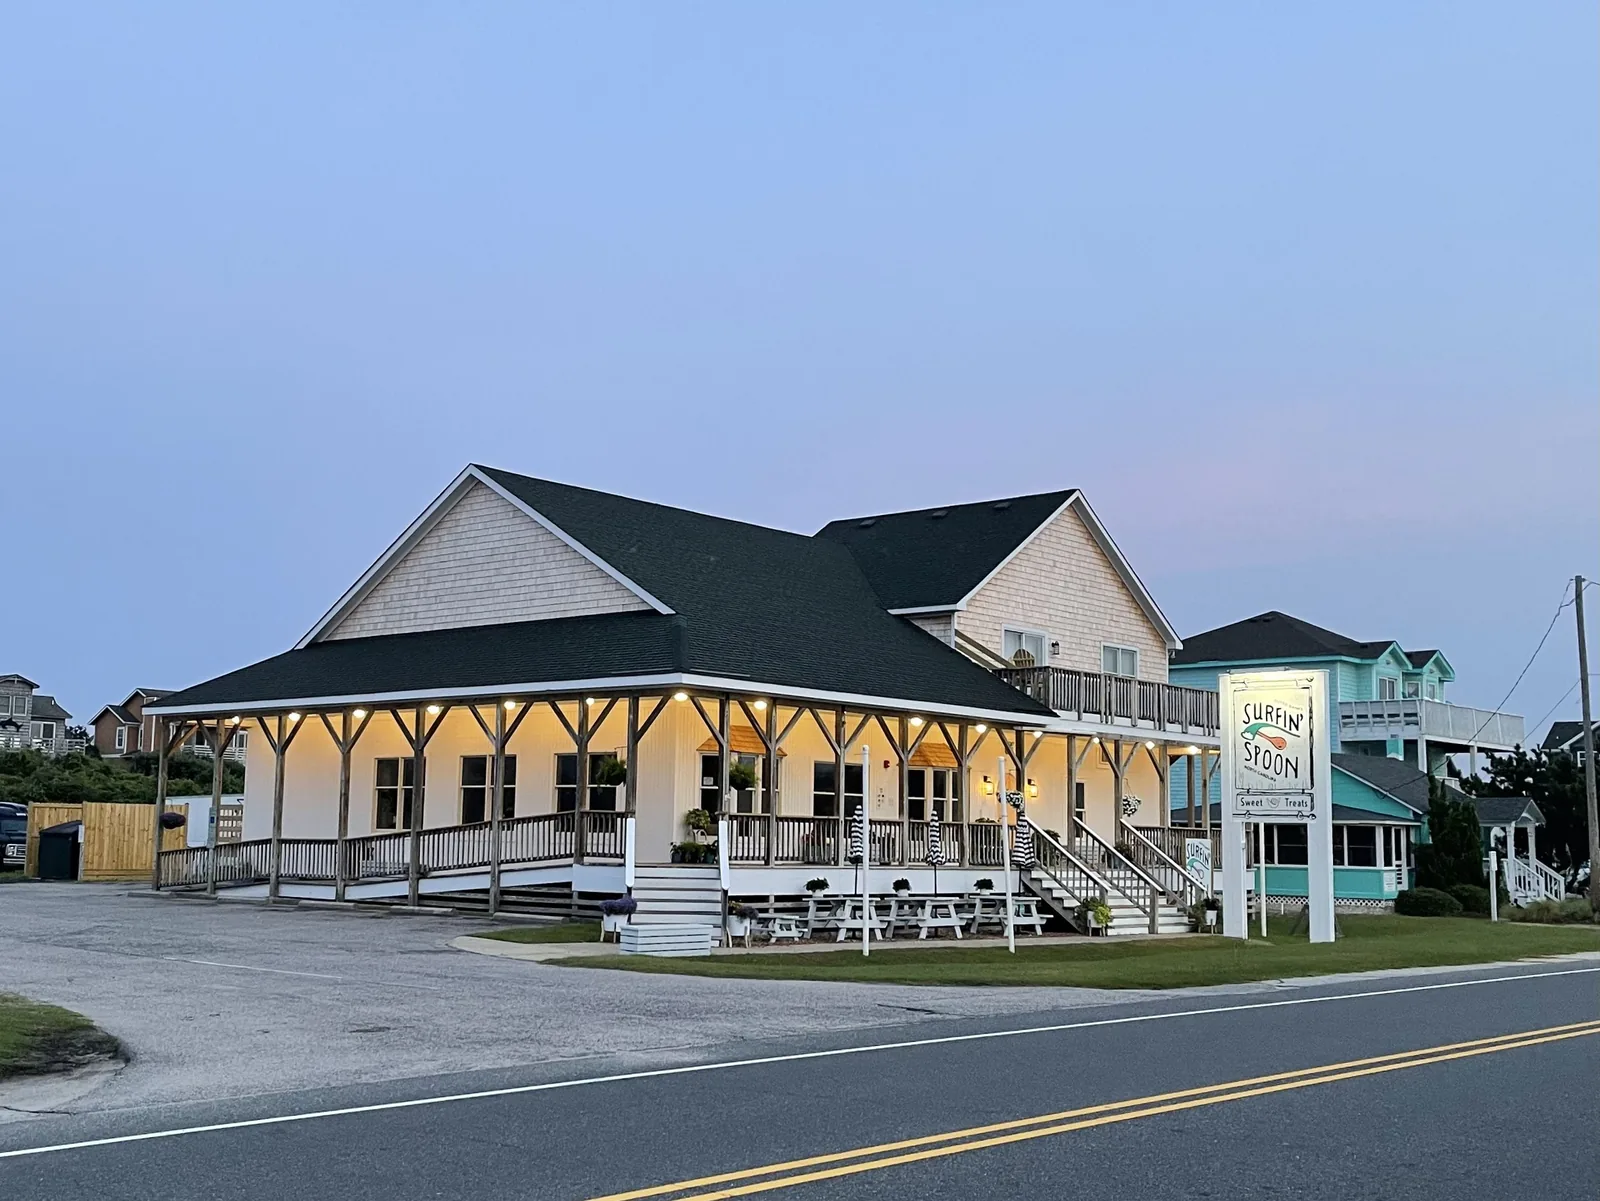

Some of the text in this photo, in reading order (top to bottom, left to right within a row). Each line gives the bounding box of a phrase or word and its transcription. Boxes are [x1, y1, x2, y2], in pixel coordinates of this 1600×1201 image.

[1242, 702, 1304, 732] SURFIN'
[1244, 741, 1299, 779] SPOON
[1240, 797, 1308, 807] Sweet Treats
